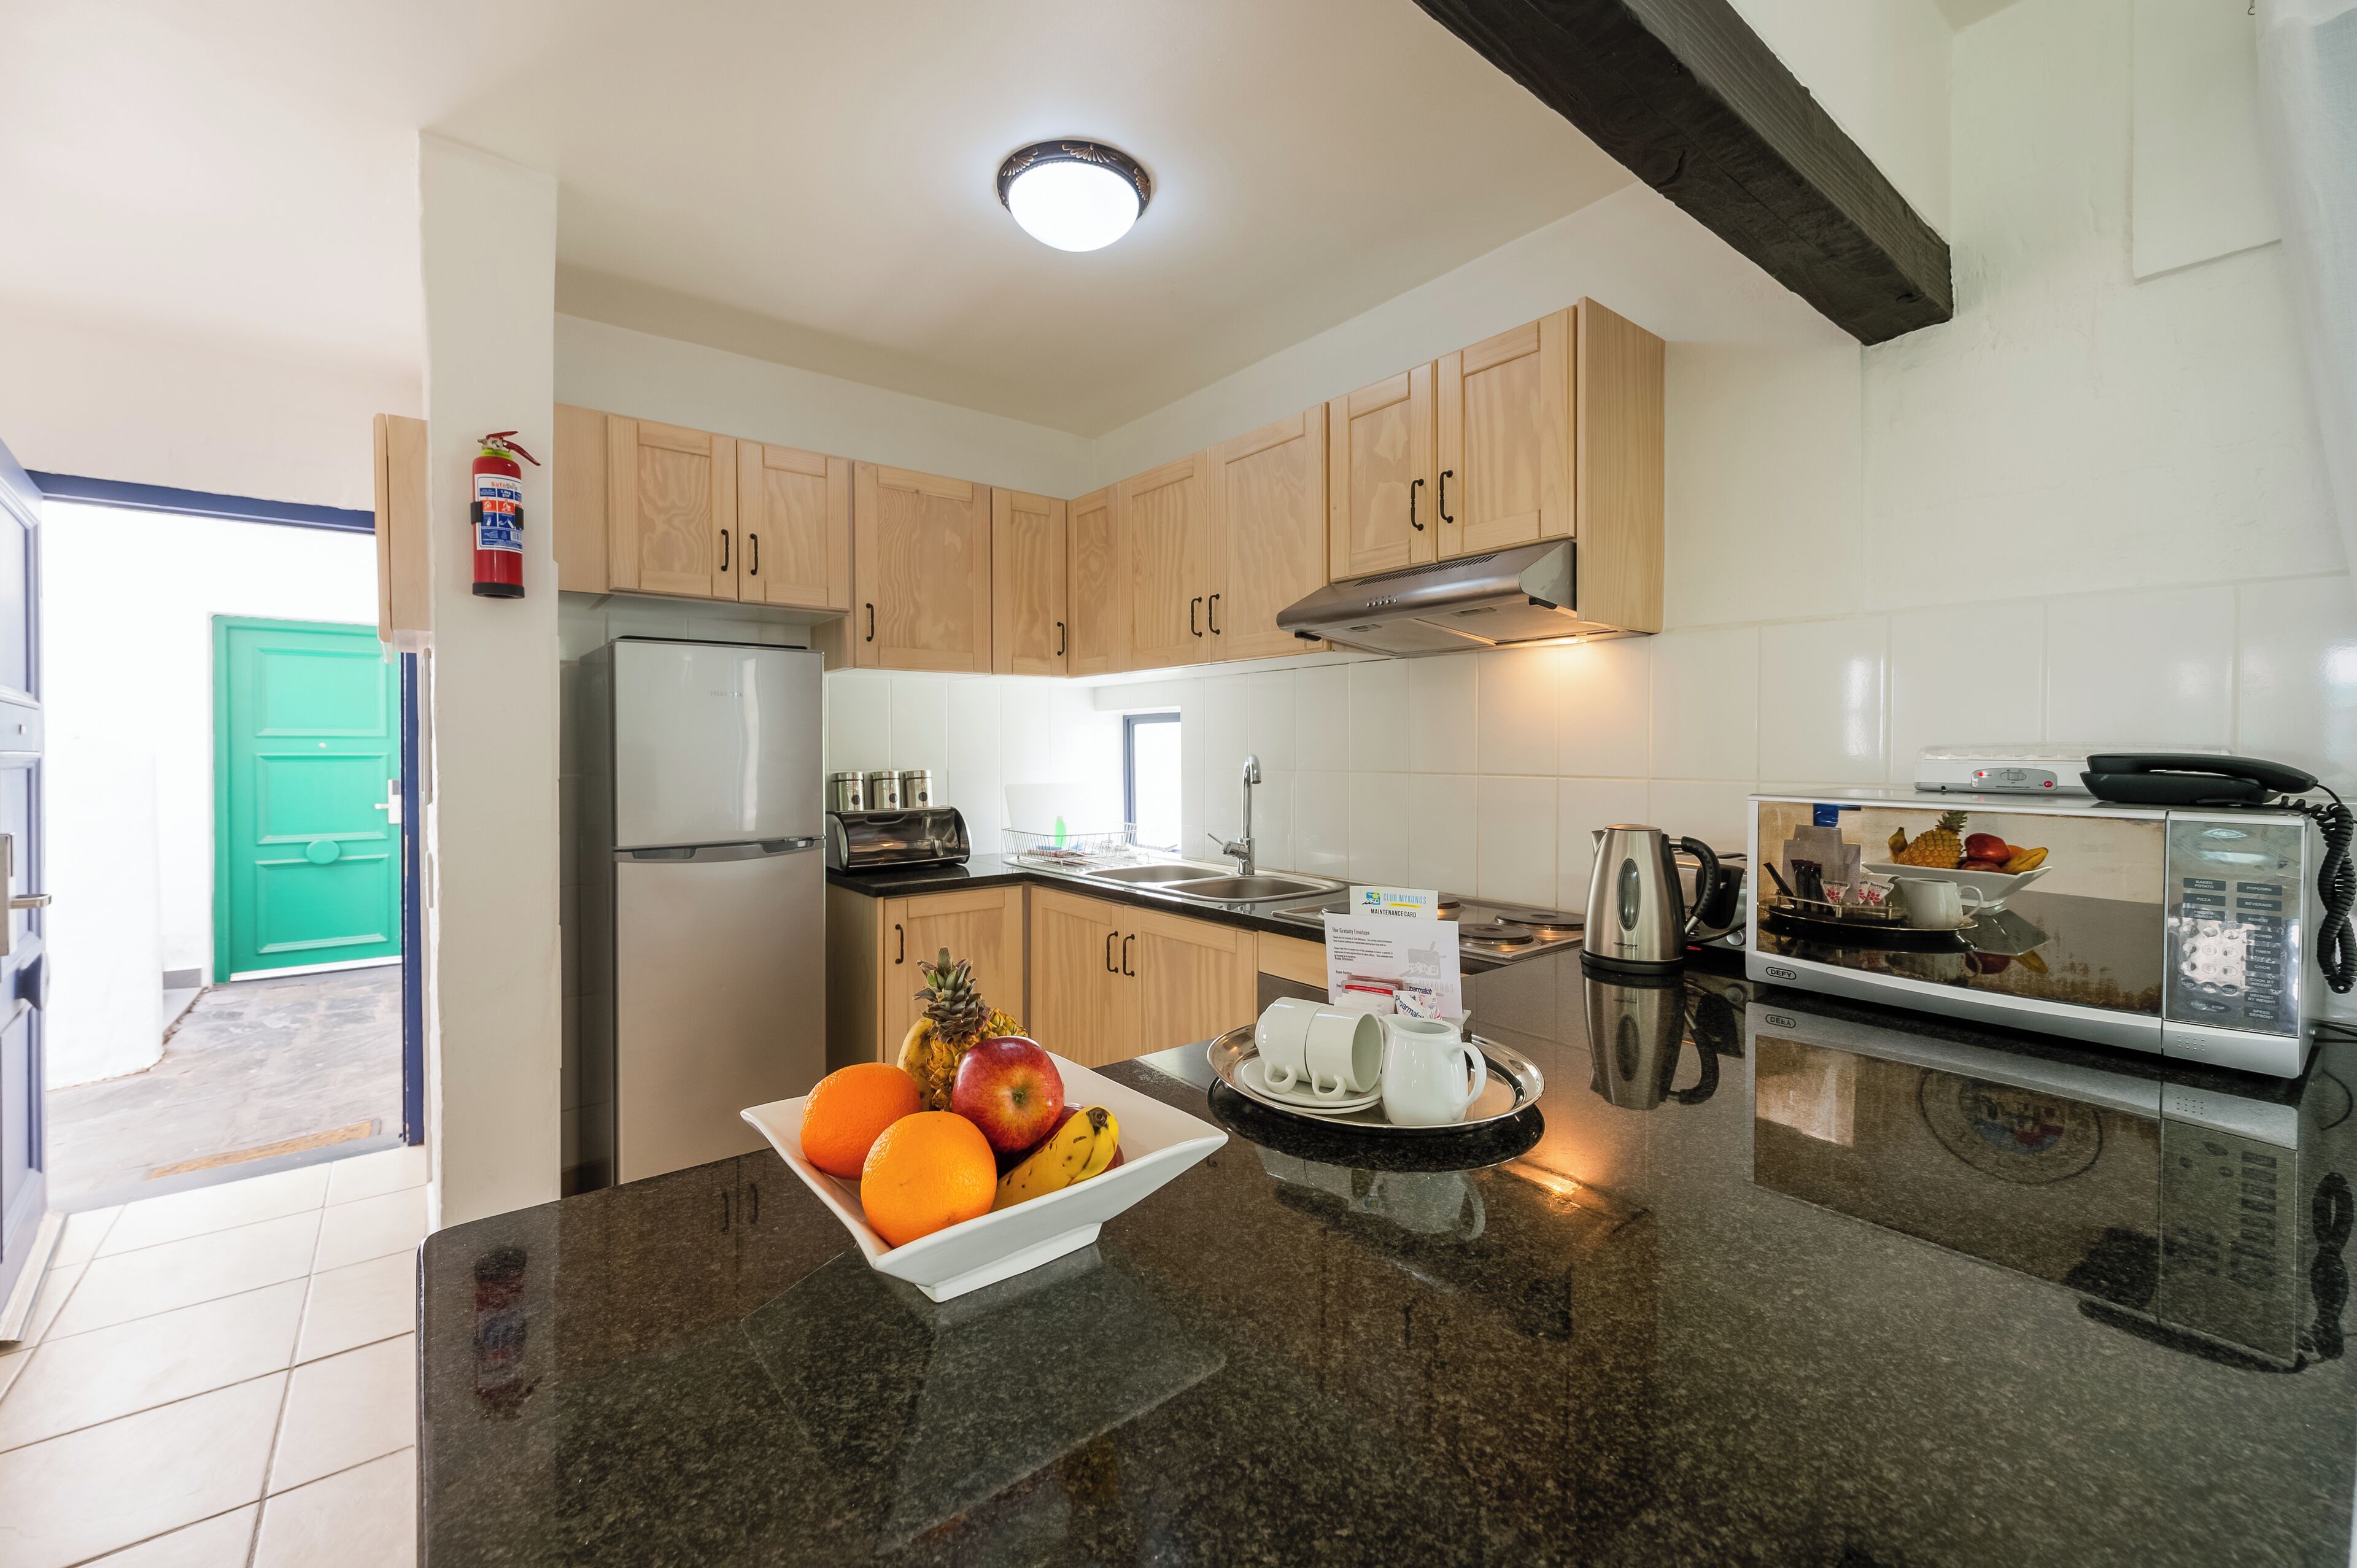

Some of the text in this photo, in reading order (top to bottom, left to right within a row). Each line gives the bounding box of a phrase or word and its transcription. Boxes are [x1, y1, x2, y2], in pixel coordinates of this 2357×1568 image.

[491, 481, 517, 490] SafeQuip
[1383, 893, 1426, 904] CLUB MYKONOS
[1409, 986, 1432, 995] parmalat
